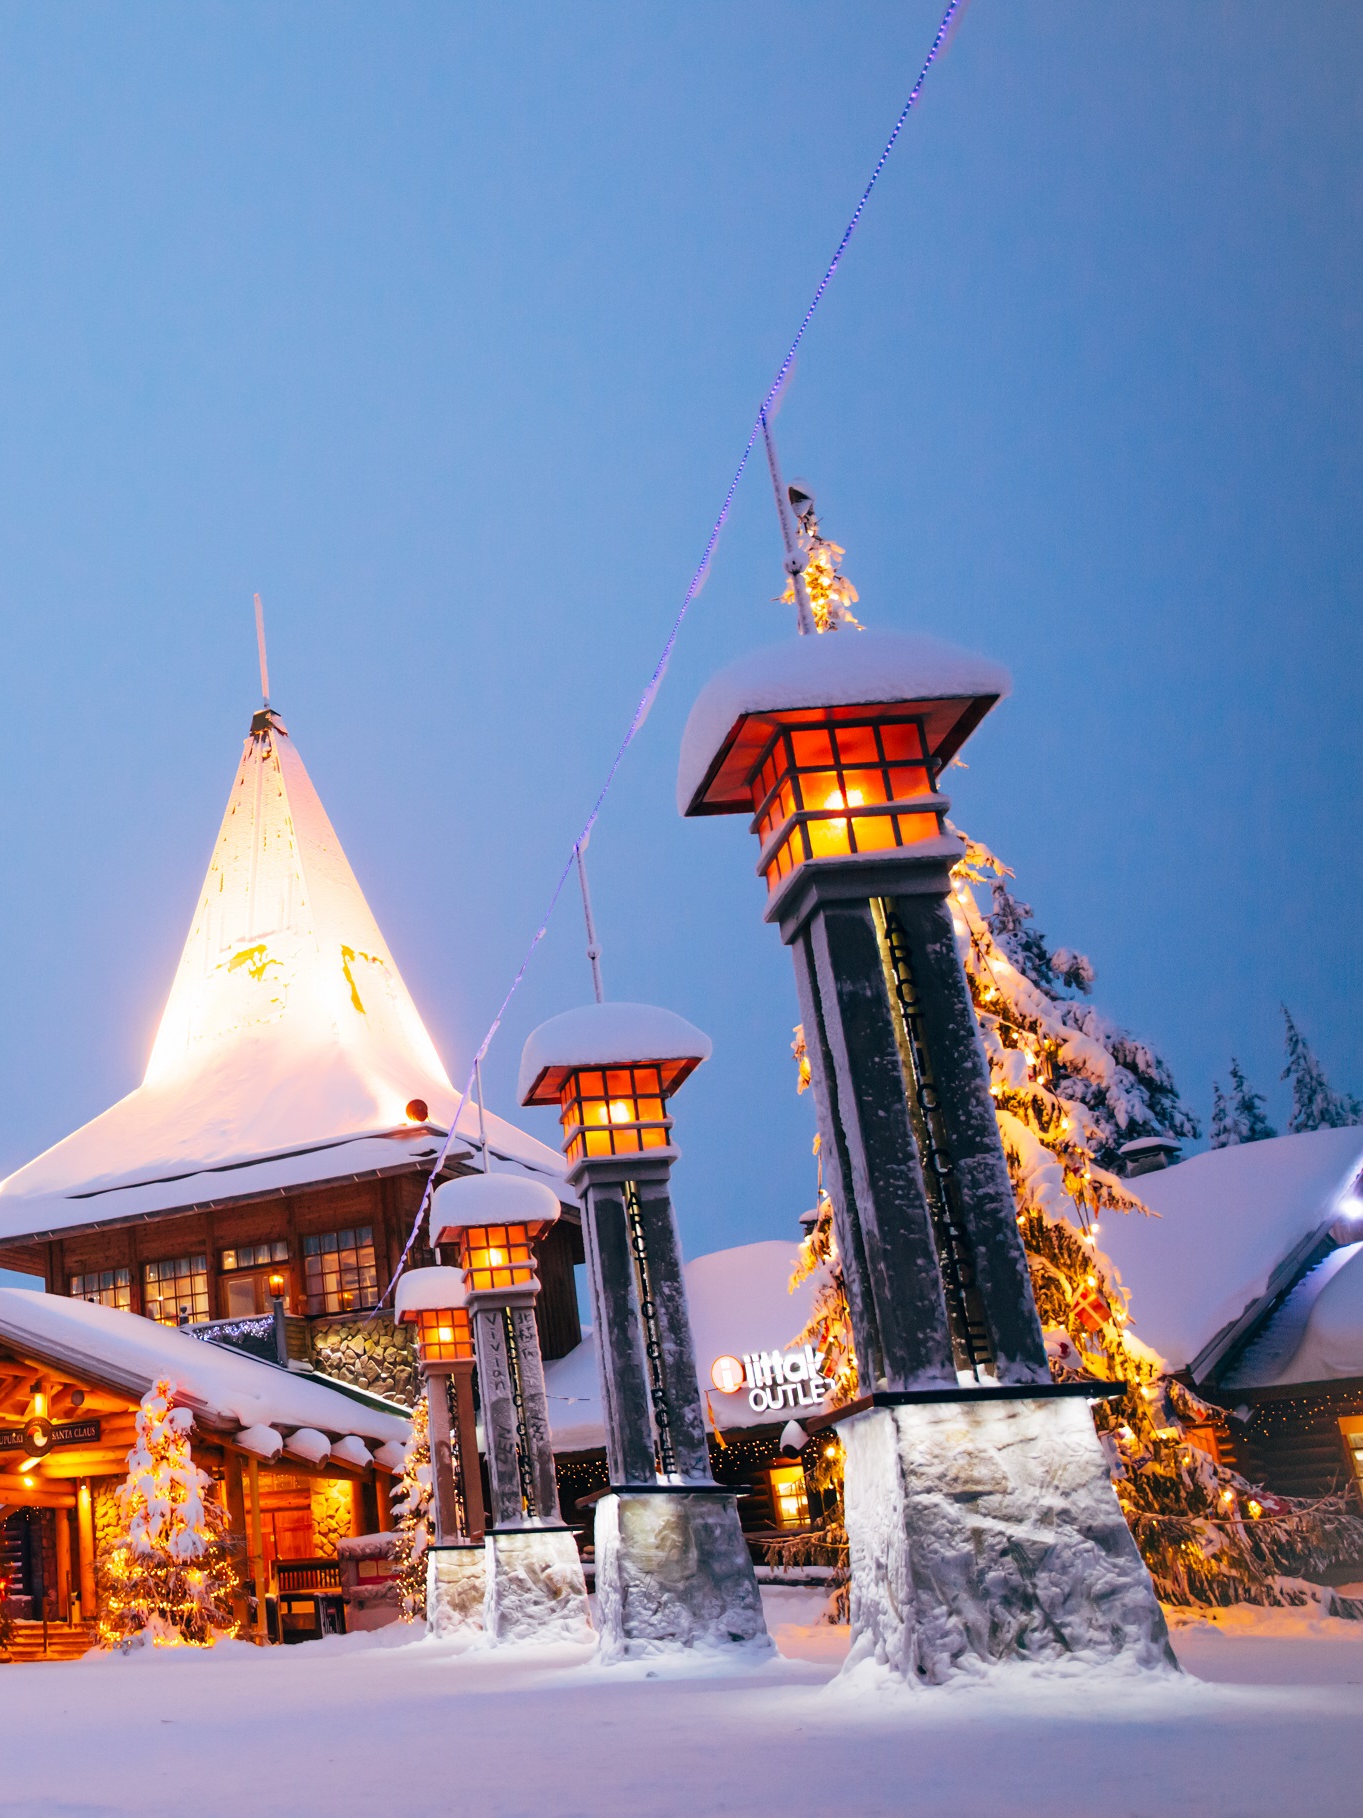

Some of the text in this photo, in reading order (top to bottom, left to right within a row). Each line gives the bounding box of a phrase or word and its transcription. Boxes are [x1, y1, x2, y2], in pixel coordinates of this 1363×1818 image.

[884, 911, 993, 1364] ARCTIC CIRCLE
[627, 1191, 678, 1474] ARCTIC CIRCLE
[742, 1344, 826, 1389] iittal
[51, 1429, 73, 1440] SANTA
[74, 1426, 96, 1438] CLAUS
